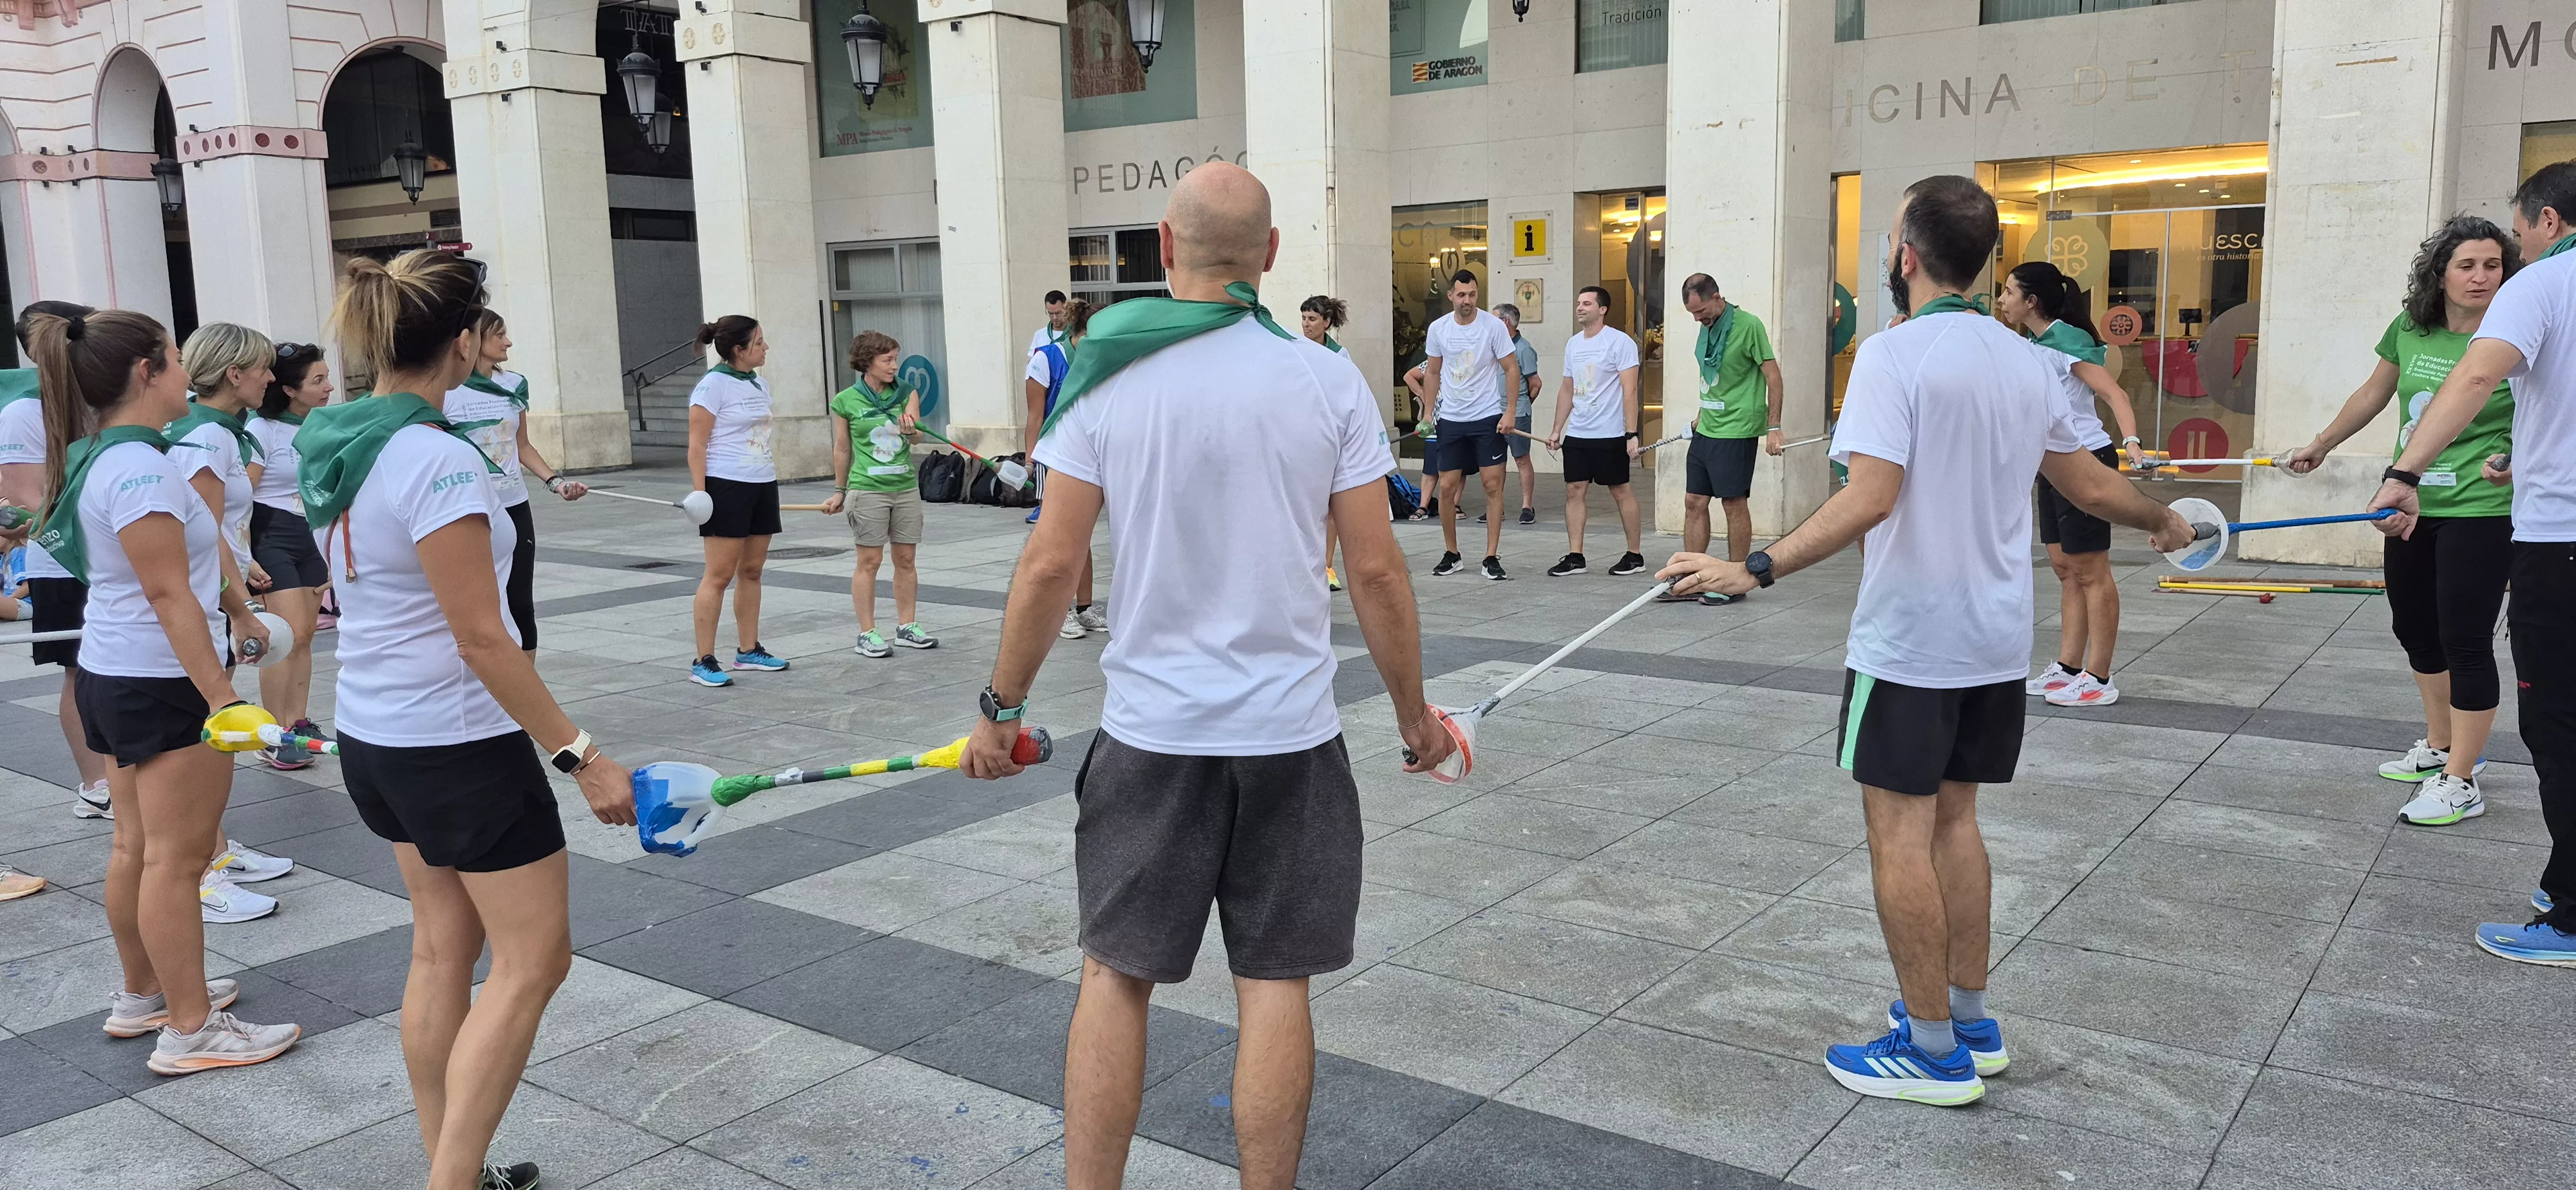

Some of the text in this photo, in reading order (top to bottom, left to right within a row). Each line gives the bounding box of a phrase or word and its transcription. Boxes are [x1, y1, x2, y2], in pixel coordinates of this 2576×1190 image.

[620, 8, 679, 36] TAT
[1602, 5, 1662, 25] Tradición
[1429, 55, 1476, 70] GOBIERNO
[1429, 65, 1483, 81] DE ARAGON
[2072, 58, 2159, 107] DE
[837, 132, 859, 147] MPA
[2208, 253, 2225, 261] otra
[2226, 252, 2259, 261] historia
[2419, 353, 2448, 364] Jornadas
[120, 475, 165, 493] ATLEET
[433, 470, 478, 494] ATLEE
